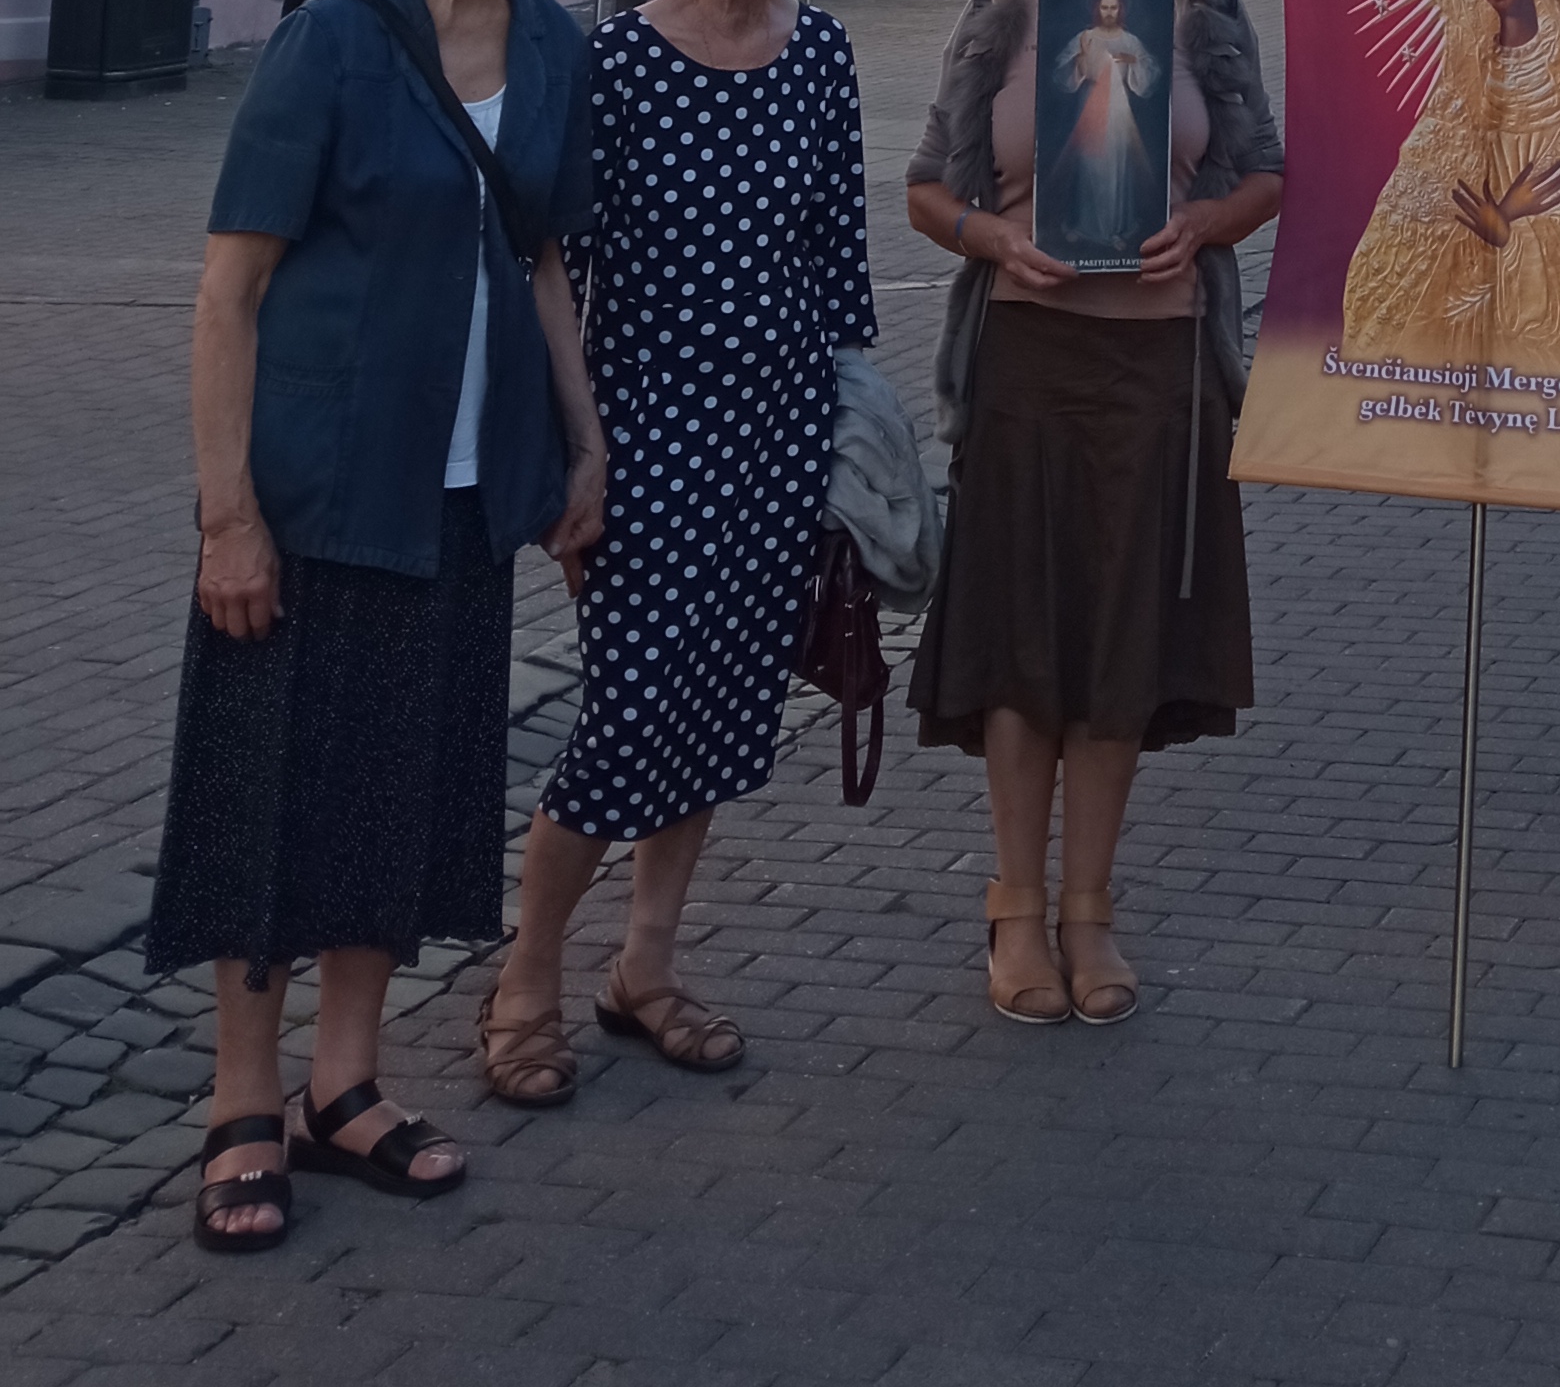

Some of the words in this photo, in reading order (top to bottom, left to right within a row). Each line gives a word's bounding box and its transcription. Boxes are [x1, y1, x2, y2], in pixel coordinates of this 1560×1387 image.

[1323, 346, 1477, 393] Švenčiausioji
[1359, 395, 1441, 422] gelbėk
[1449, 400, 1538, 434] Tėvynę
